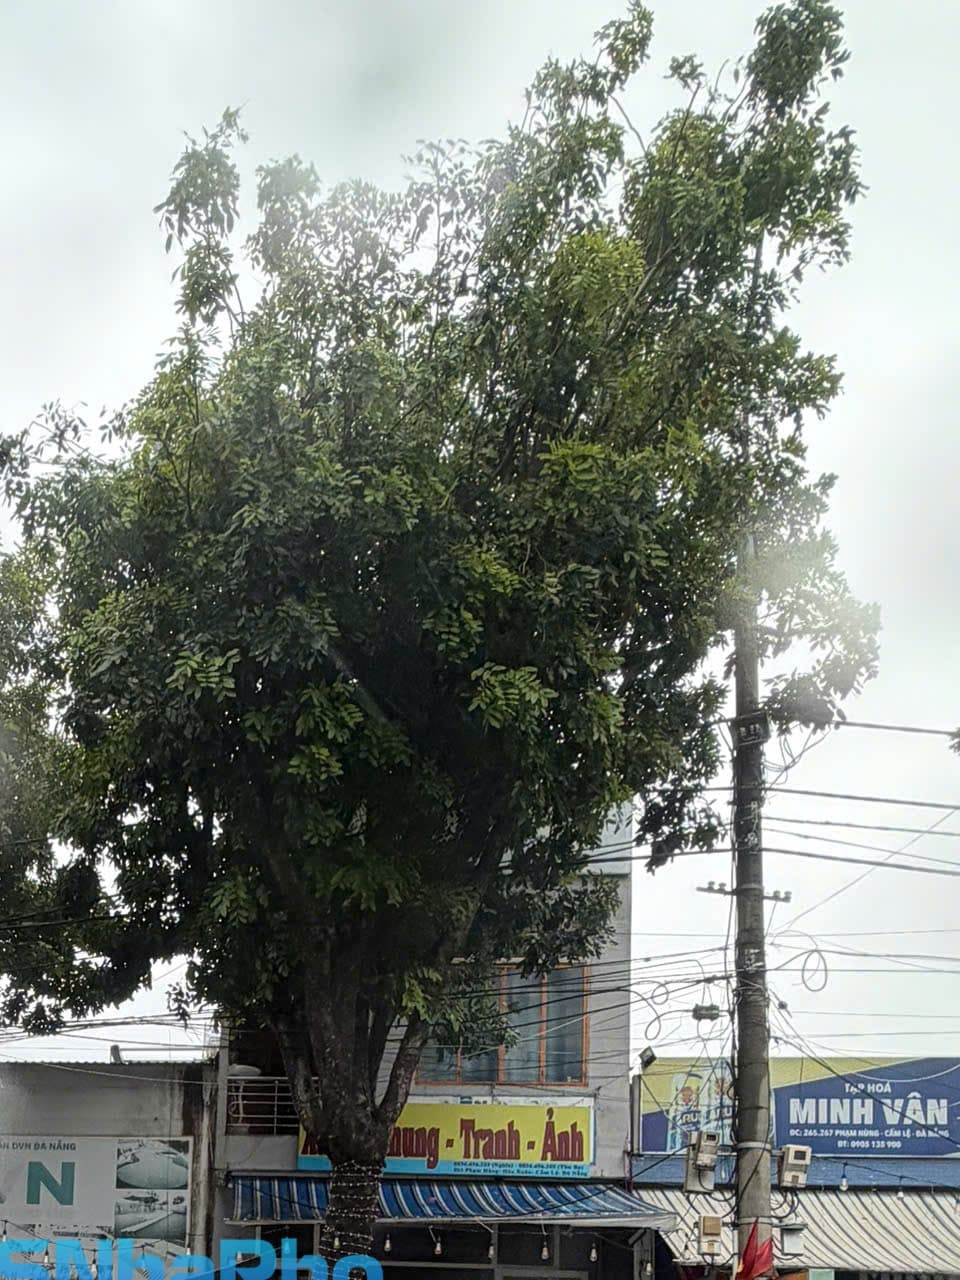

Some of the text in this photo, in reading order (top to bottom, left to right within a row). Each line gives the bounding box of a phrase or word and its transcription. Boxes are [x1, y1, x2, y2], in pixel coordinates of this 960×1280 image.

[790, 1091, 948, 1125] MINH VÂN
[460, 1118, 520, 1160] Tranh
[541, 1107, 584, 1162] Ảnh
